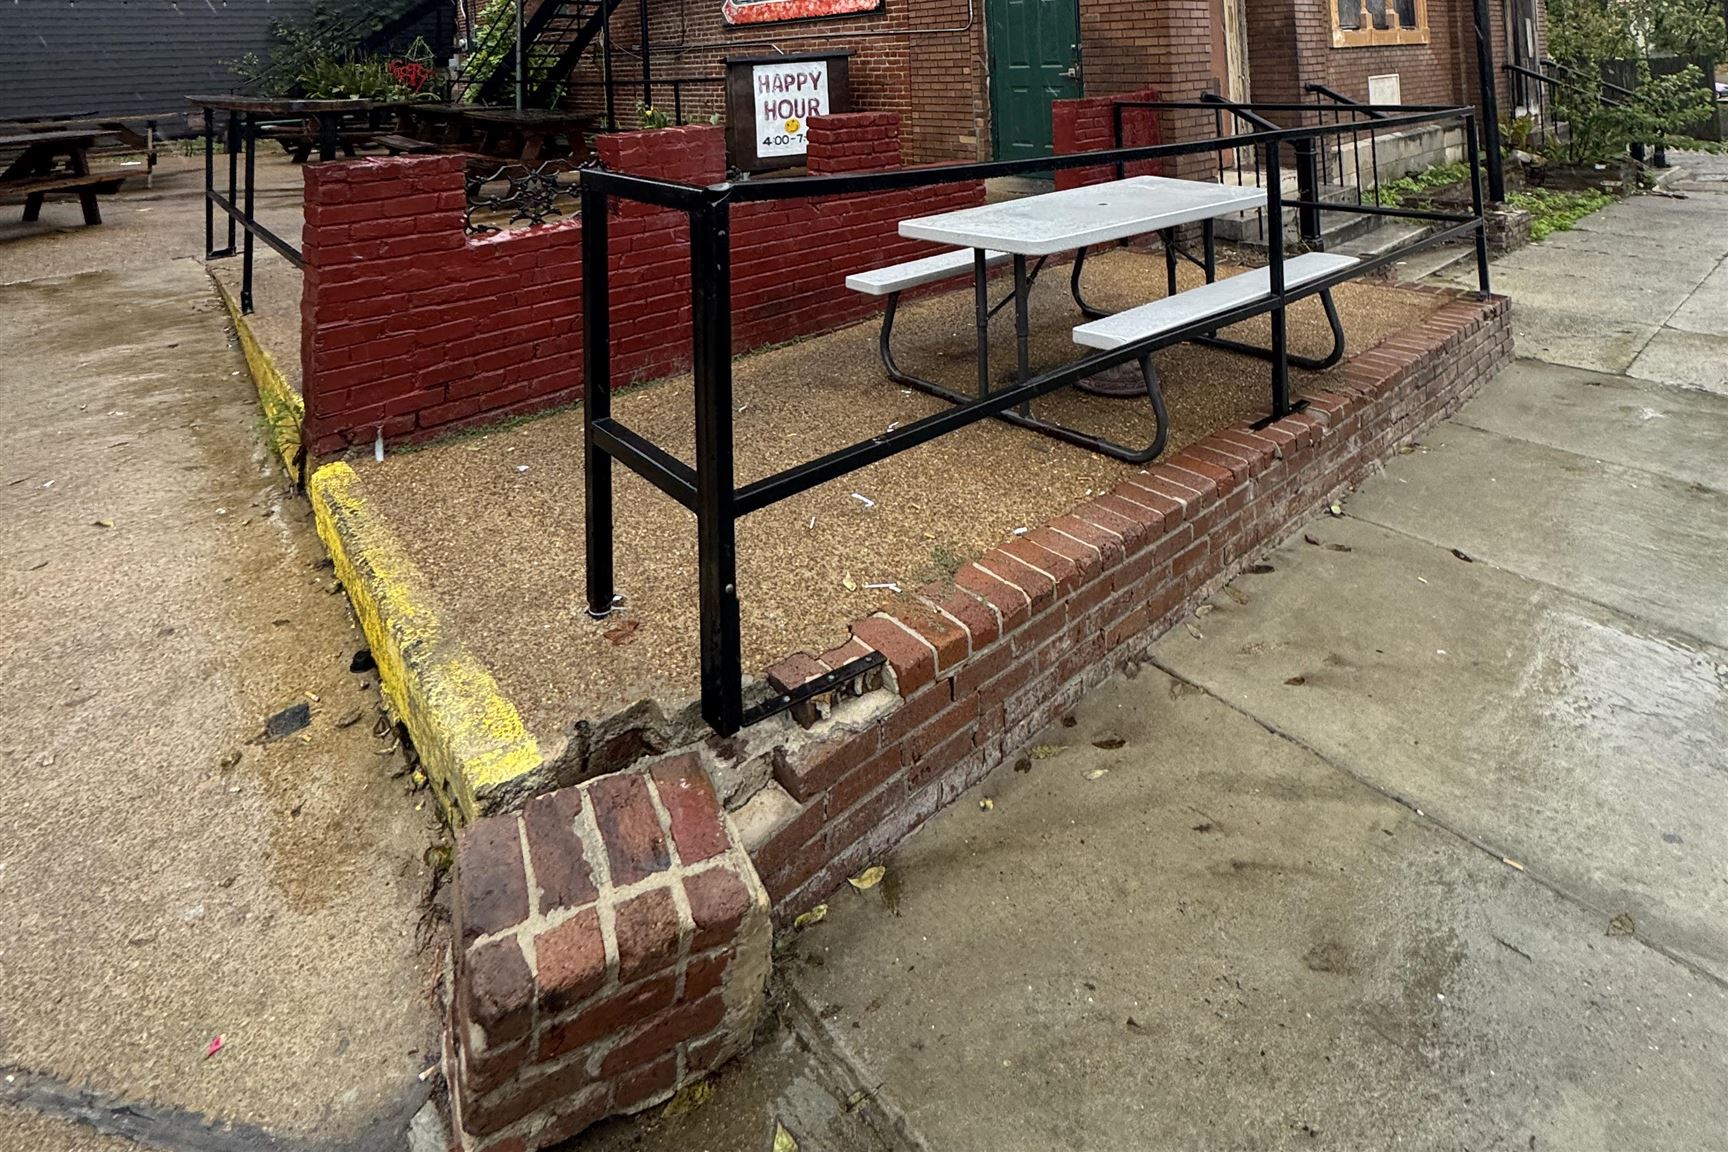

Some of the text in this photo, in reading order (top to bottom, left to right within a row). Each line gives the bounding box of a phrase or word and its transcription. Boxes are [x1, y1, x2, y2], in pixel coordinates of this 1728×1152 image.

[758, 71, 822, 94] HAPPY
[764, 98, 820, 121] HOUR
[763, 134, 807, 146] 4:00-7:
